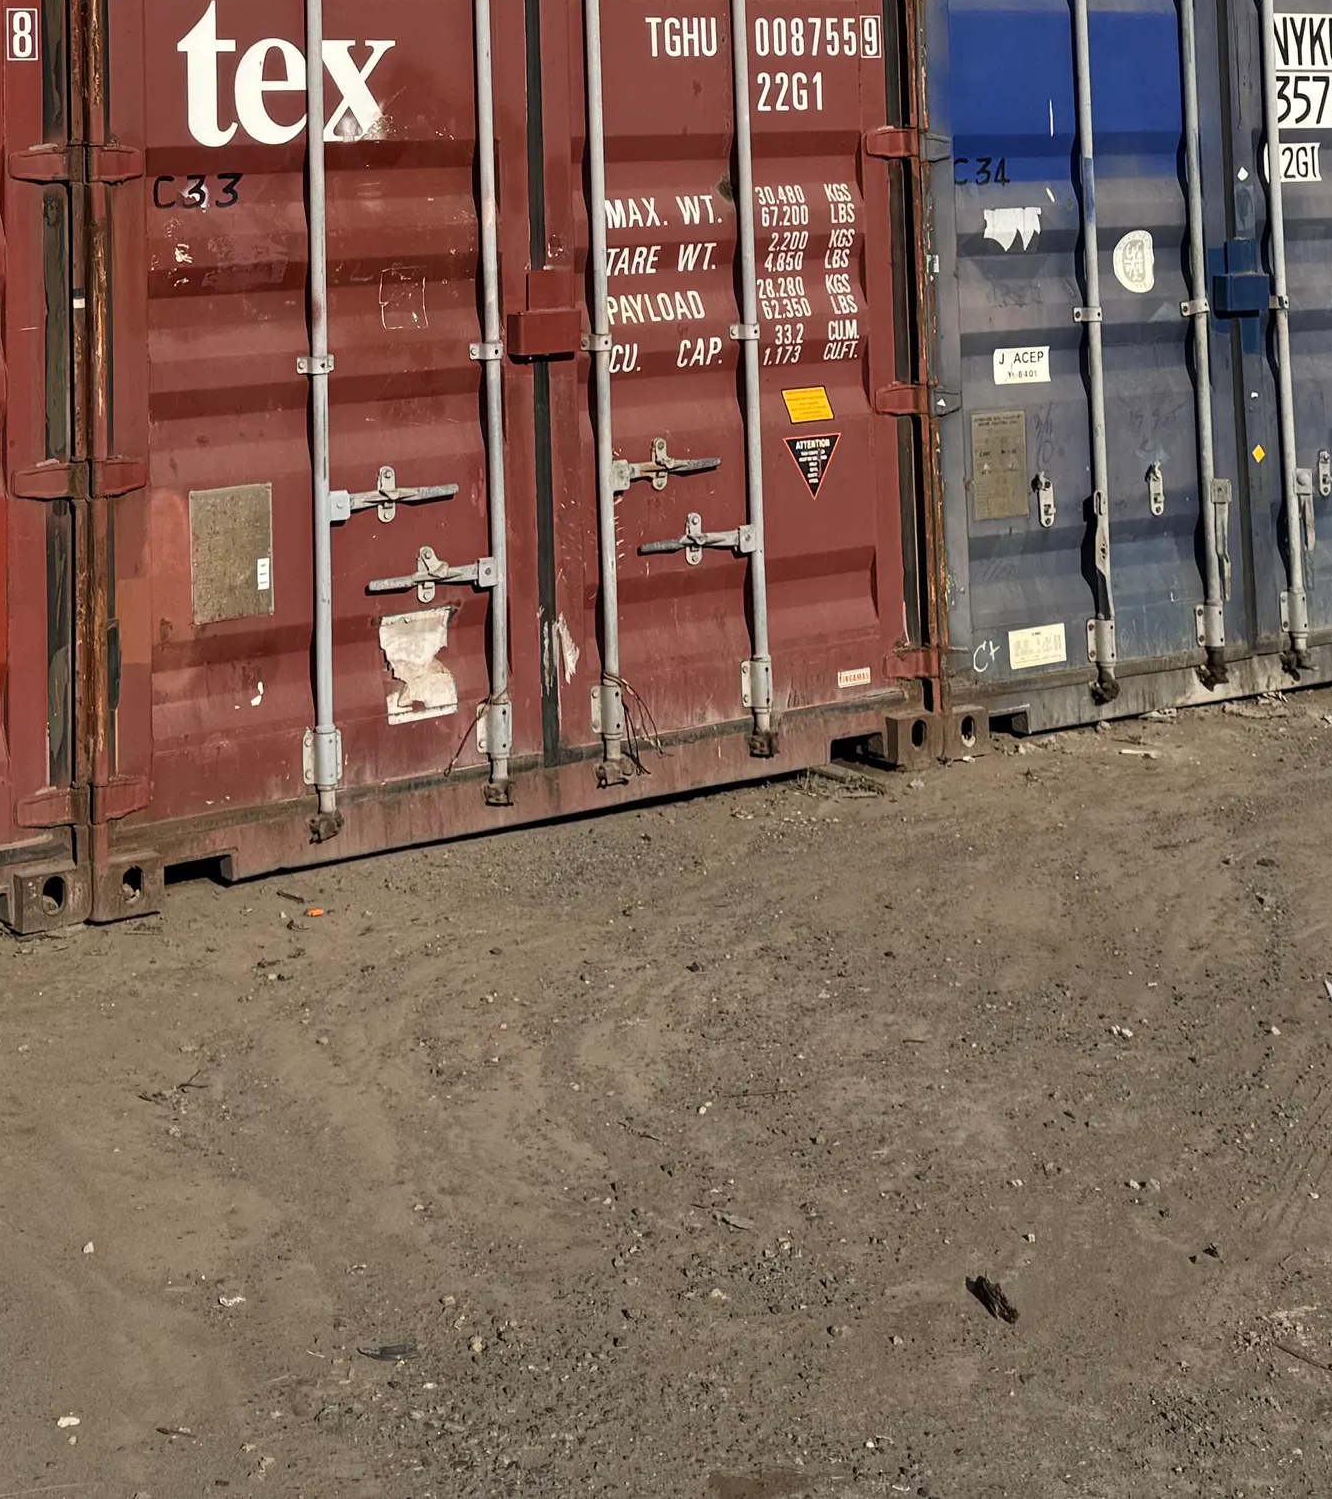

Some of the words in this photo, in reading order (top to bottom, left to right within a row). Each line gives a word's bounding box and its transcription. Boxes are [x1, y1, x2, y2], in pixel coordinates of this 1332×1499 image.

[11, 11, 34, 58] 8
[644, 16, 718, 58] TGHU
[754, 17, 857, 57] 008755
[863, 17, 879, 57] 9
[176, 0, 396, 148] tex
[756, 71, 823, 112] 22G1
[1280, 146, 1318, 179] 2G1
[153, 172, 244, 210] C33
[754, 185, 805, 205] 30.480
[824, 183, 852, 202] KGS
[605, 197, 668, 228] MAX.
[675, 195, 723, 226] WT.
[761, 205, 809, 227] 67.200
[830, 203, 855, 224] LBS
[768, 231, 809, 252] 2.200
[828, 228, 855, 248] KGS
[606, 245, 661, 277] TARE
[677, 242, 717, 272] WT.
[763, 251, 804, 272] 4.850
[824, 249, 850, 269] LBS
[756, 276, 805, 299] 28.280
[825, 273, 851, 294] KGS
[607, 290, 706, 325] PAYLOAD
[761, 298, 812, 320] 62.350
[832, 293, 858, 315] LBS
[774, 323, 804, 345] 33.2
[608, 343, 642, 374] CU.
[676, 336, 723, 368] CAP.
[763, 347, 802, 367] 1.173
[1013, 350, 1045, 364] ACEP
[795, 438, 830, 450] ATTENTION
